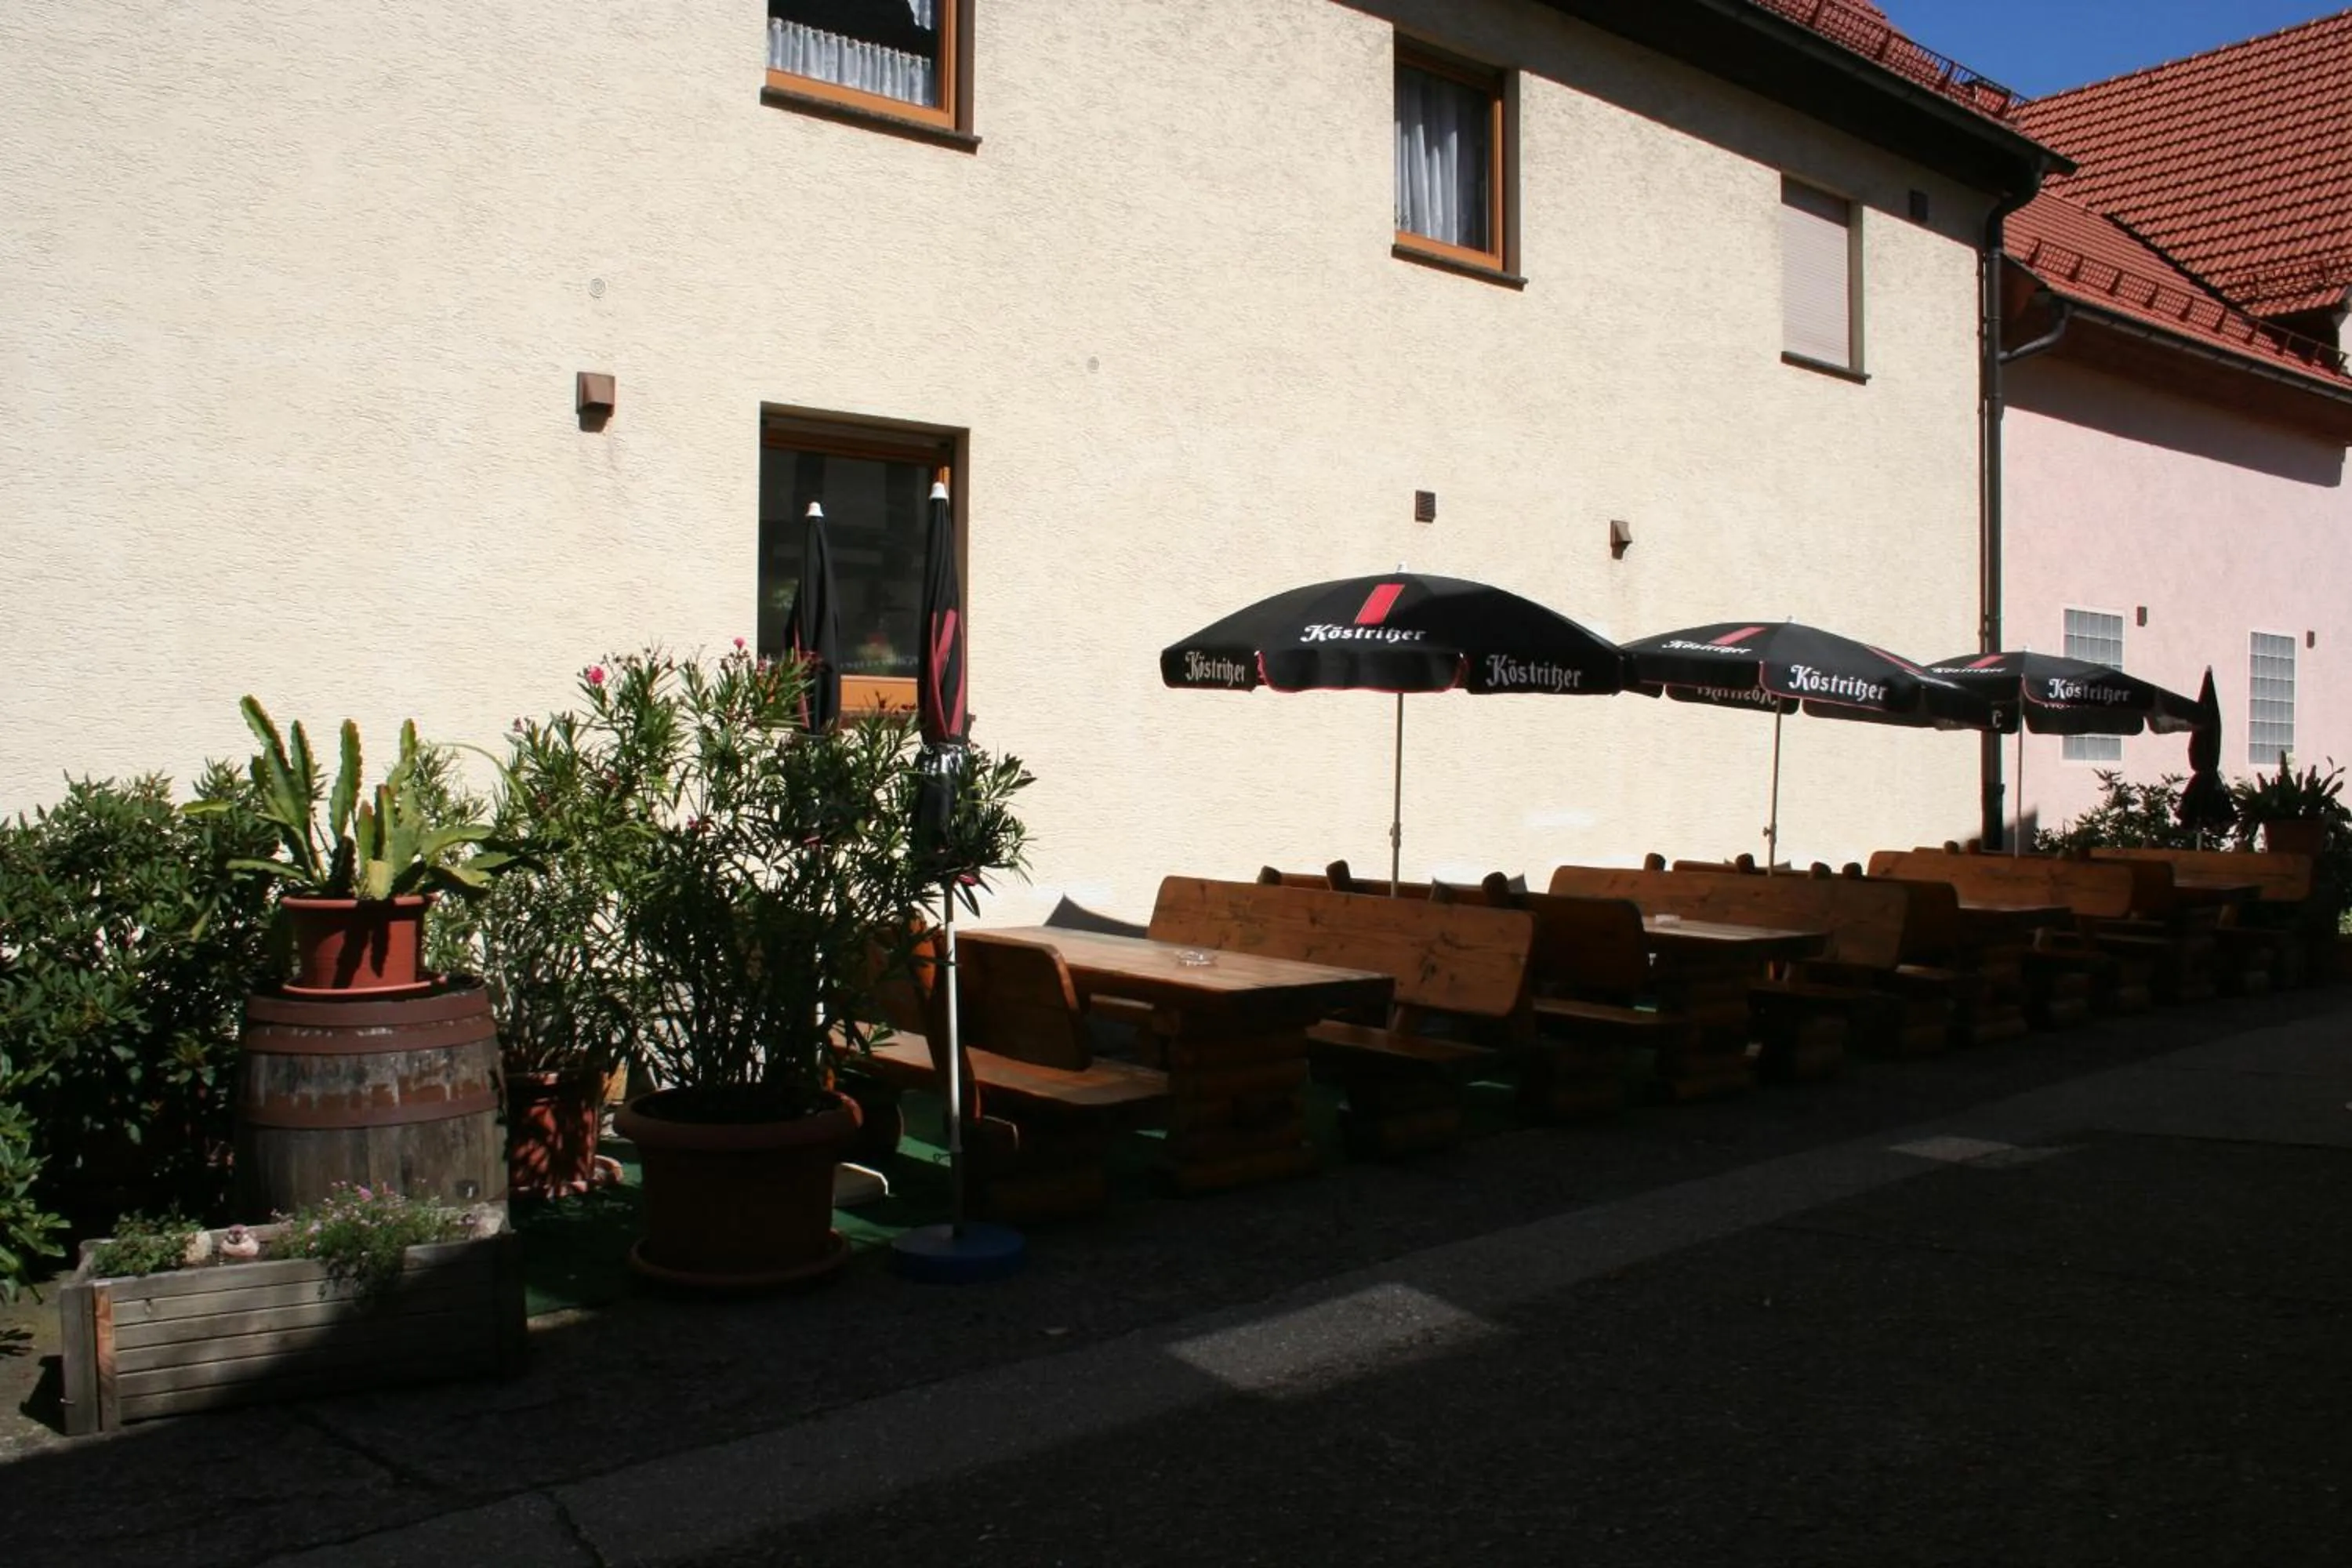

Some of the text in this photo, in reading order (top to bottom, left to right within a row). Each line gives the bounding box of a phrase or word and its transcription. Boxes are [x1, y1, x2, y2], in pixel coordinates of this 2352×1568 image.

[1301, 624, 1426, 643] Köstritzer
[1185, 650, 1245, 687] Köstritzer
[1485, 654, 1581, 692] Köstritzer
[1788, 664, 1888, 702] Köstritzer
[2048, 678, 2131, 705] Köstritzer
